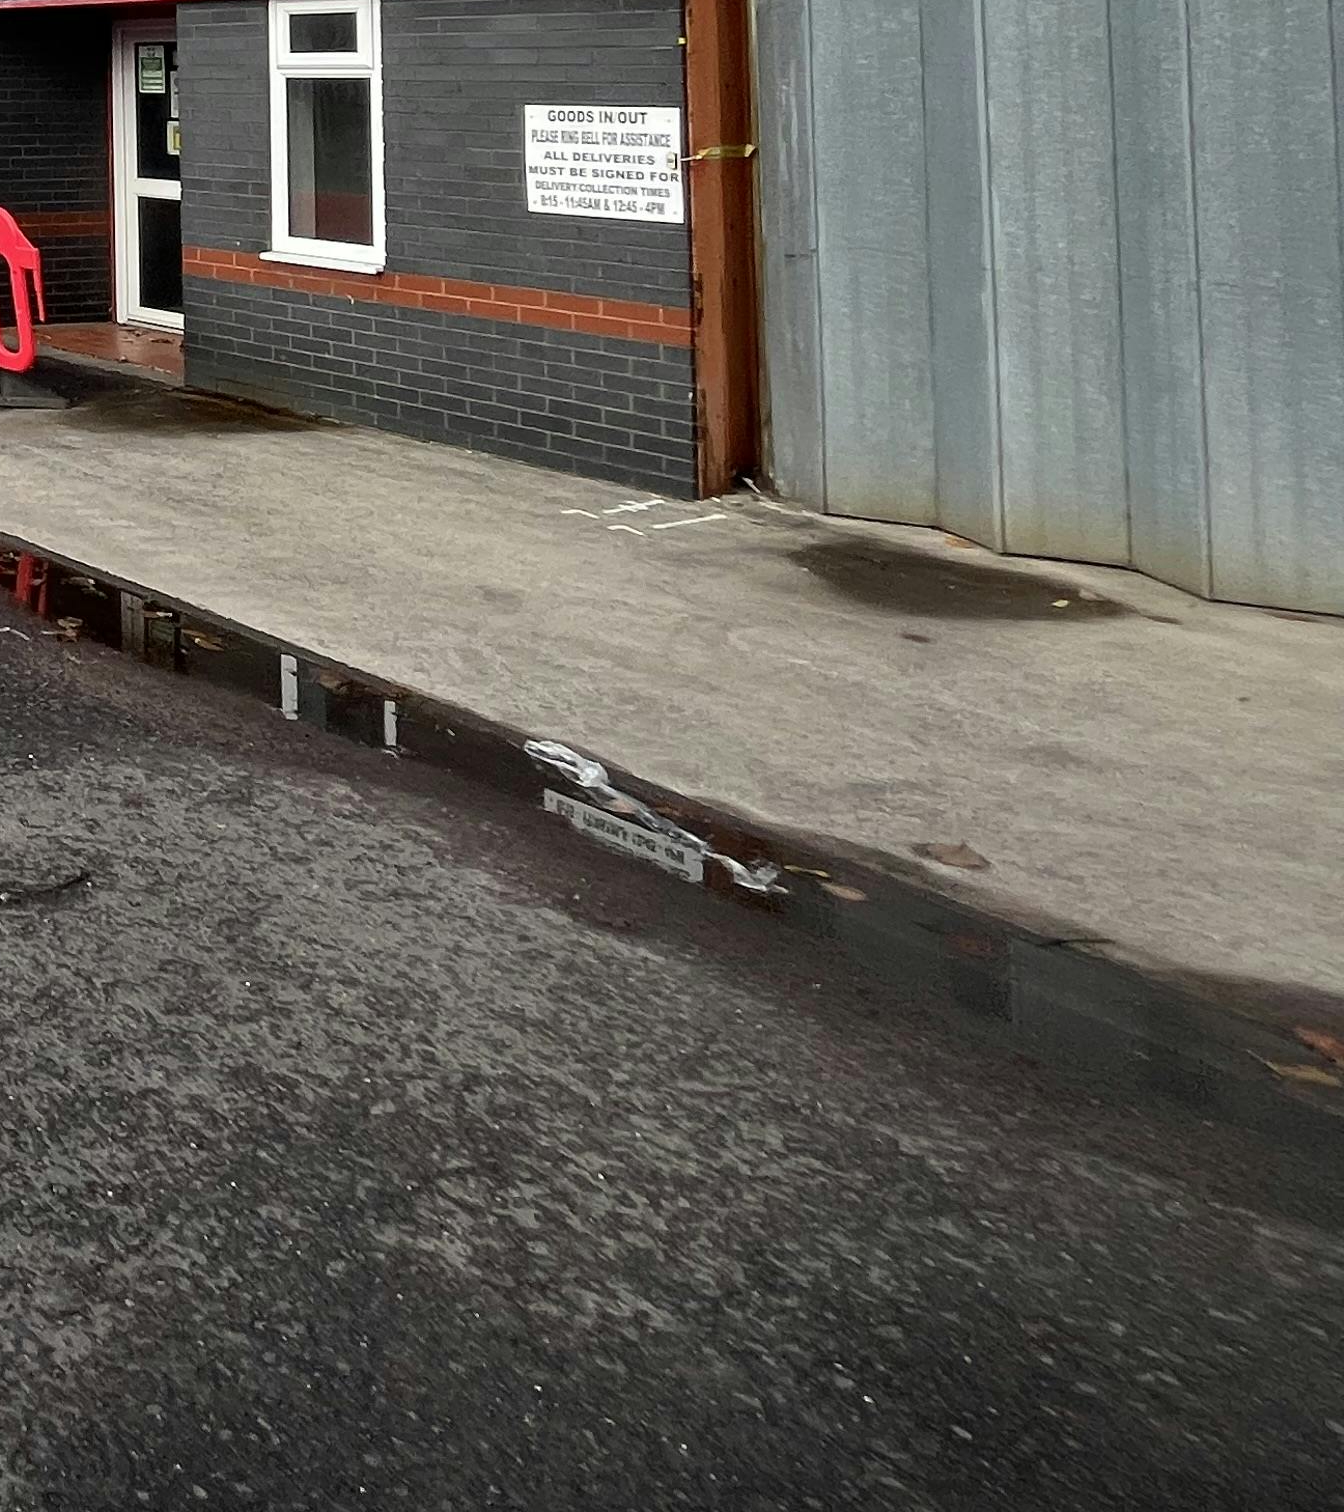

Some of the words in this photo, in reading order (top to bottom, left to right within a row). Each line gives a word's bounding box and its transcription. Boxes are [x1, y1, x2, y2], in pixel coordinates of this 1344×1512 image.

[547, 110, 595, 123] GOODS
[531, 129, 559, 143] PLEASE
[560, 130, 579, 144] RING
[581, 131, 600, 145] BELL
[602, 131, 618, 145] FOR
[620, 132, 671, 148] ASSISTANCE
[543, 150, 569, 161] ALL
[572, 151, 656, 165] DELIVERIES
[528, 165, 566, 176] MUST
[569, 167, 587, 178] BE
[591, 168, 645, 180] SIGNED
[649, 171, 680, 182] FOR
[640, 187, 671, 198] TIMES
